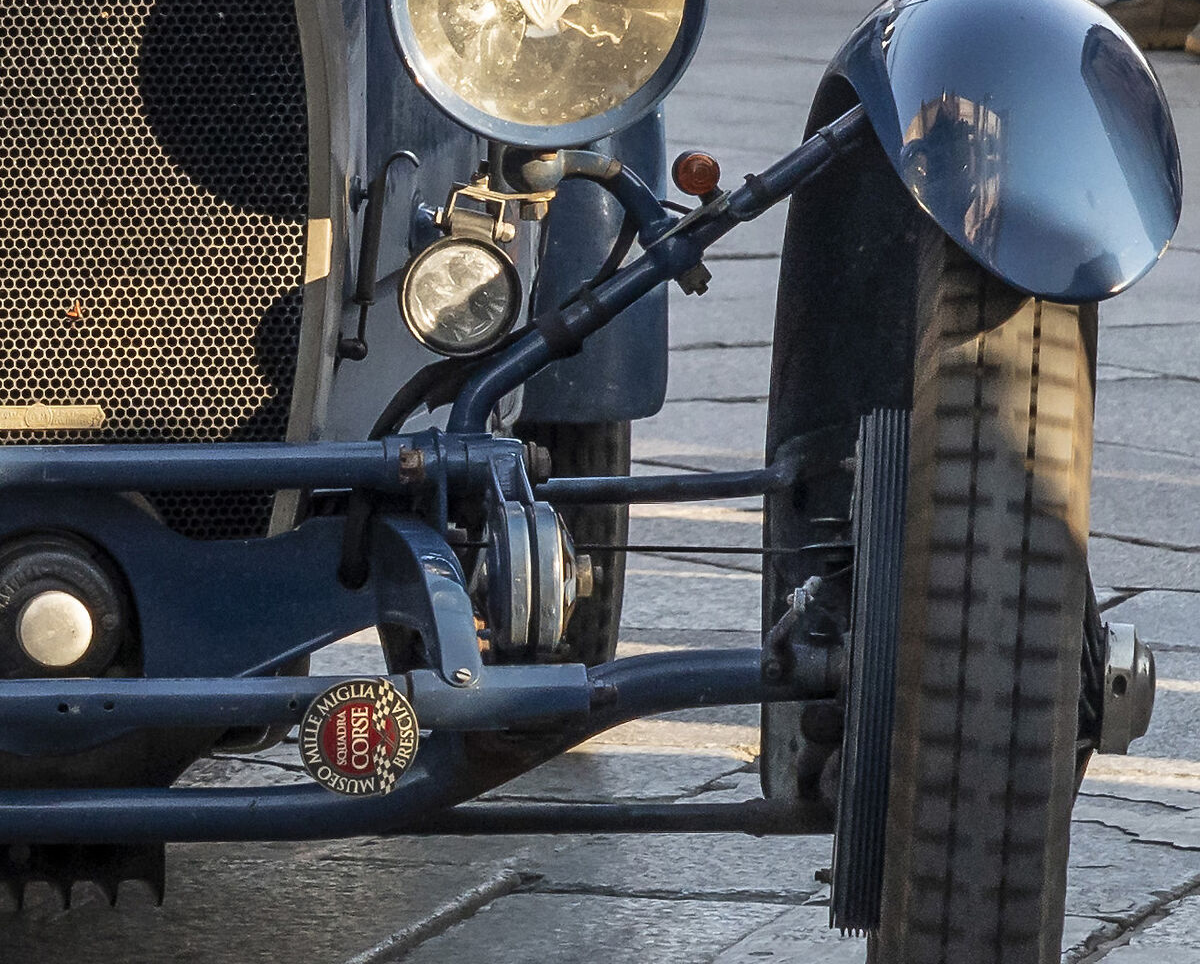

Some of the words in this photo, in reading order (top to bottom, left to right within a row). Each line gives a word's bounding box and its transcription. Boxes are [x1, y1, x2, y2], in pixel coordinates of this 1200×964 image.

[316, 684, 376, 717] MIGLIA
[304, 714, 323, 764] MILLE
[336, 710, 348, 766] SQUADRA
[351, 706, 370, 770] CORSE
[391, 700, 414, 769] BRESCIA
[317, 765, 375, 793] MUSEO
